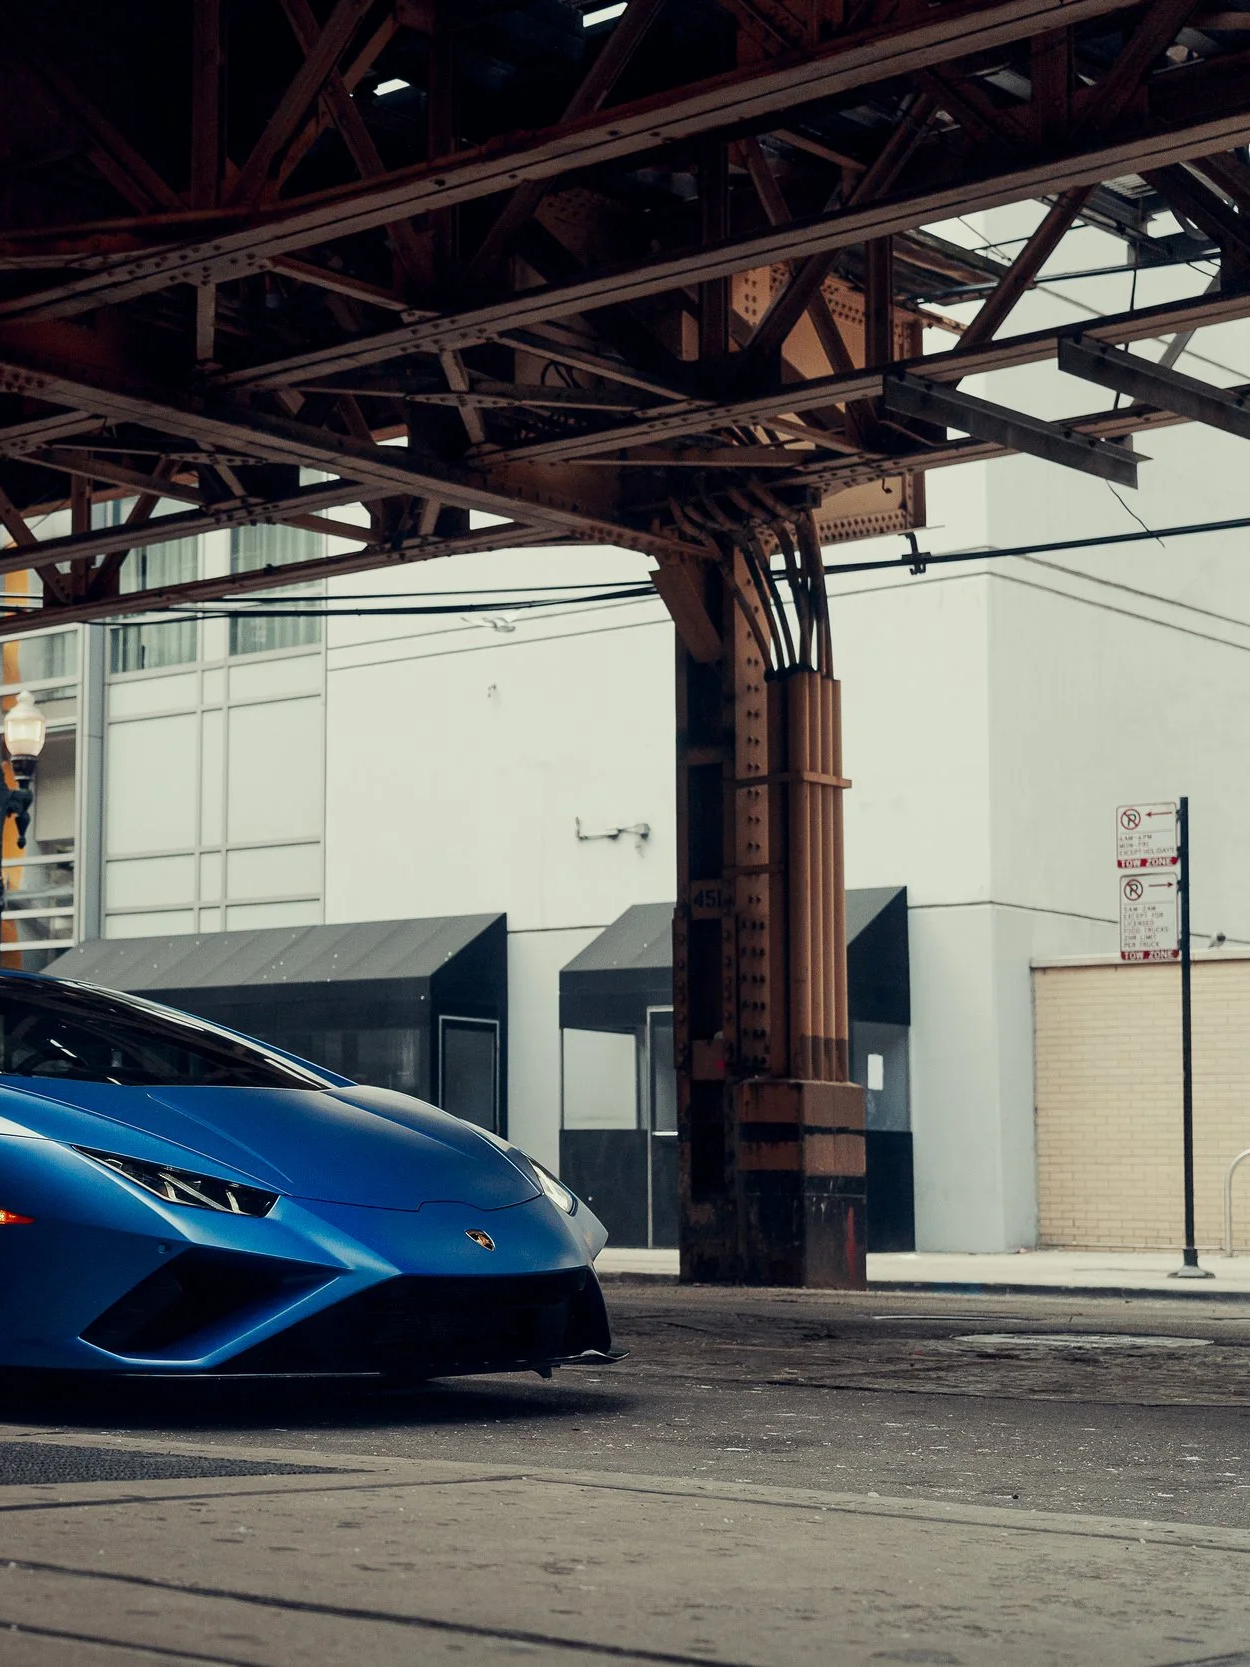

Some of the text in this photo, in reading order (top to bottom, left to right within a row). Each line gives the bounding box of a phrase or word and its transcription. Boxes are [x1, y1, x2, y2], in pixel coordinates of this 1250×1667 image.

[1121, 857, 1171, 868] TOW ZONE
[693, 889, 721, 908] 451
[1123, 950, 1173, 960] TOW ZONE
